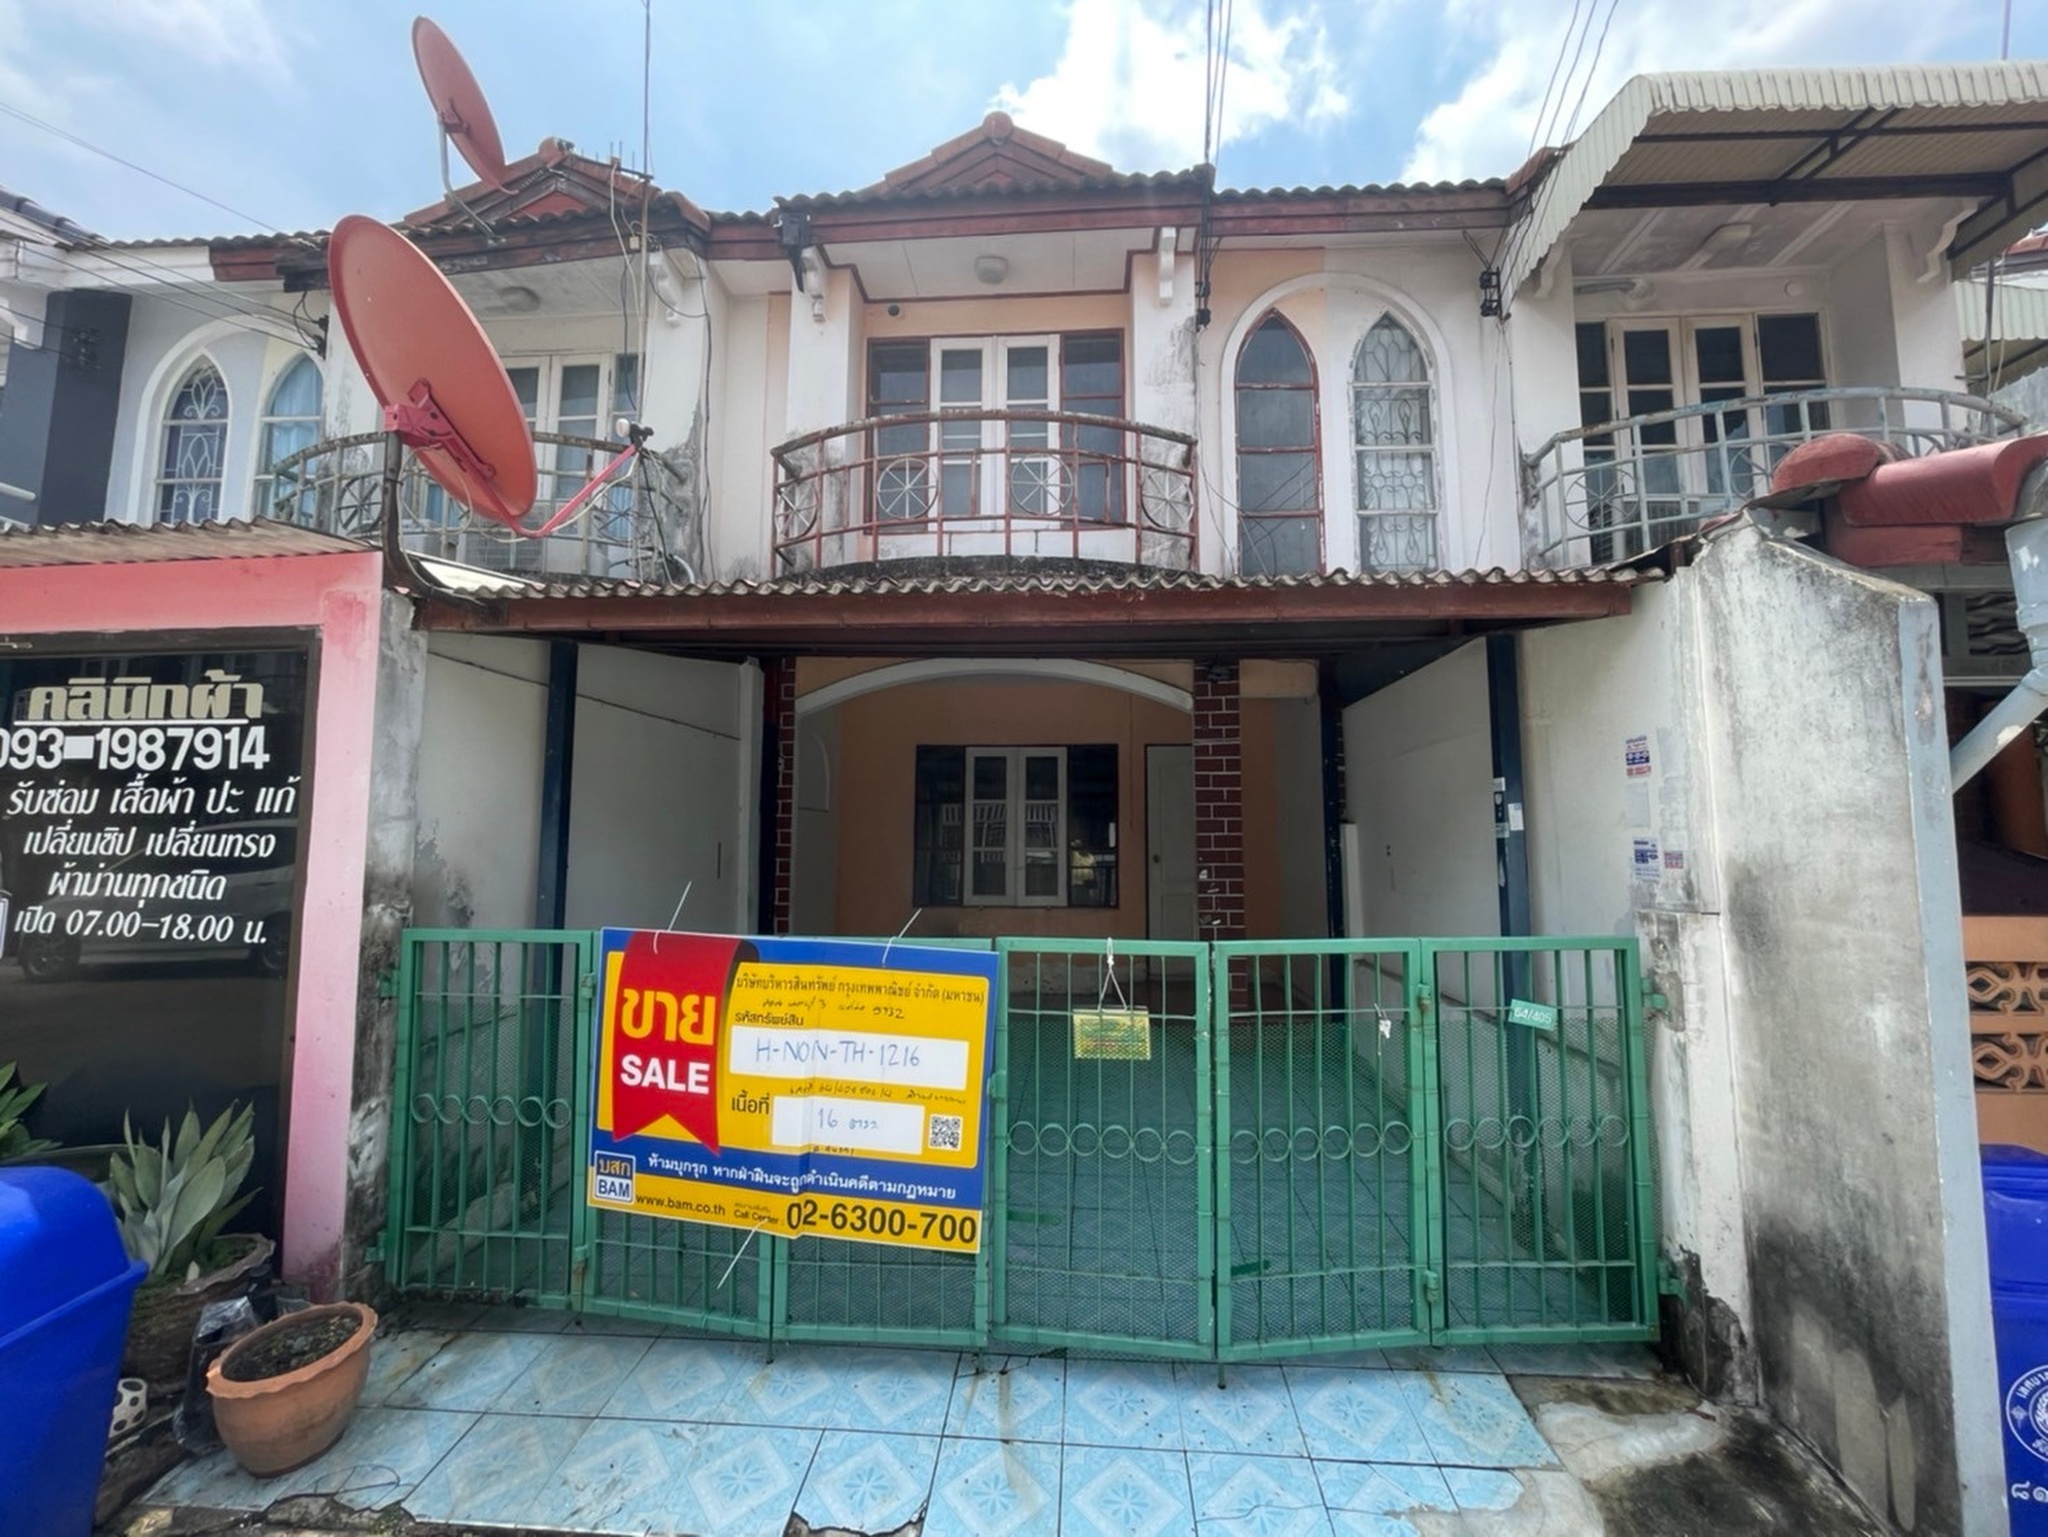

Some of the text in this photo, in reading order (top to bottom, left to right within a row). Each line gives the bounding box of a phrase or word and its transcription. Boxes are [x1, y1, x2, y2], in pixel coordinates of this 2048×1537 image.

[27, 669, 264, 719] คลินิกผ้า
[6, 773, 301, 815] รับซ่อม เสื้อผ้า ปะ แก้
[23, 818, 276, 858] เปลี่ยนซิป เปลี่ยนทรง
[48, 862, 227, 908] ผ้าม่านทุกชนิด
[14, 905, 56, 934] เปิด
[243, 920, 267, 944] น.
[621, 988, 716, 1046] ขาย
[620, 1054, 710, 1095] SALE
[731, 1090, 770, 1114] เนื้อที่
[818, 1107, 838, 1129] 16
[599, 1158, 631, 1177] บสก
[648, 1153, 708, 1178] ห้ามบุกรุก
[598, 1179, 630, 1198] BAM
[635, 1195, 726, 1216] www.bam.co.th
[734, 1208, 749, 1219] Call
[786, 1199, 977, 1244] 02-6300-700
